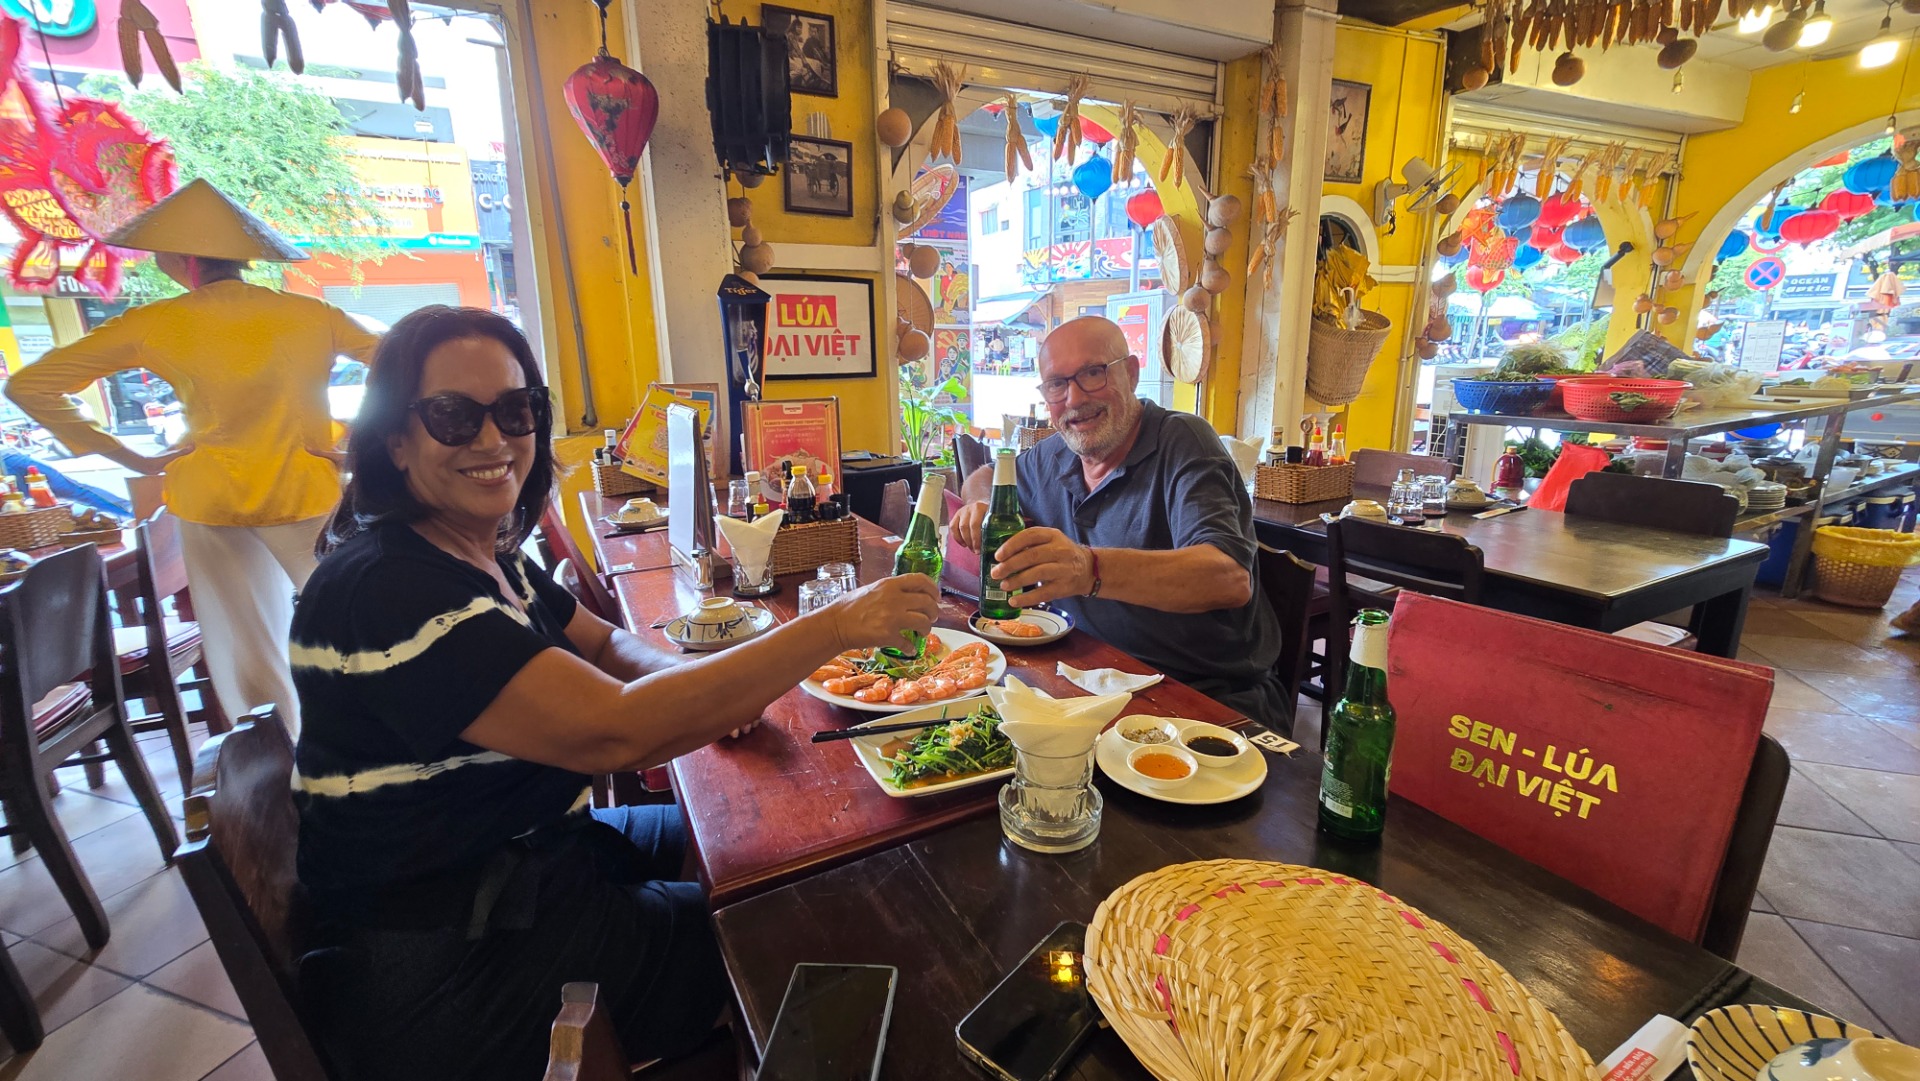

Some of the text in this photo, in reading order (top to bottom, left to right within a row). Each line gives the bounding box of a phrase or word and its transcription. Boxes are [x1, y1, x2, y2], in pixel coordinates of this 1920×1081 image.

[724, 286, 758, 296] Tiger
[1791, 276, 1828, 284] OCEAN
[781, 297, 832, 325] LÚA
[803, 328, 861, 362] VIỆT
[1257, 735, 1289, 747] 15
[1448, 715, 1517, 755] SEN
[1543, 749, 1619, 793] LÚA
[1450, 747, 1601, 819] ĐẠI VIỆT
